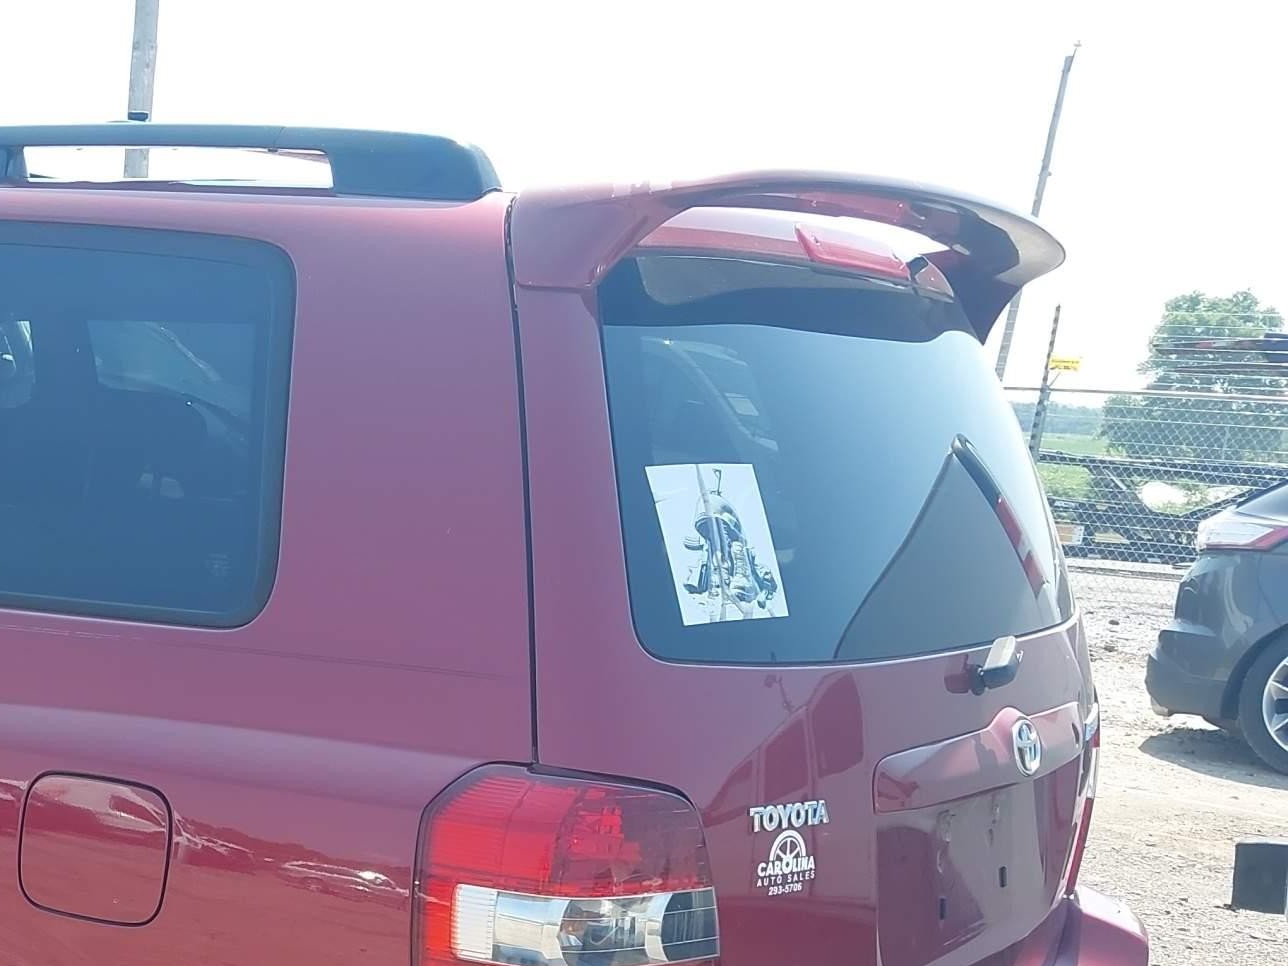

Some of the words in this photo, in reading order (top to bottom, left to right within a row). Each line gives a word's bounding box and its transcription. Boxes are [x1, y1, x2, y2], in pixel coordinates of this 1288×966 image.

[749, 800, 830, 832] TOYOTA
[757, 855, 816, 877] CAROLINA
[756, 876, 783, 887] AUTO
[787, 870, 815, 882] SALES
[768, 882, 802, 896] 293-5706
